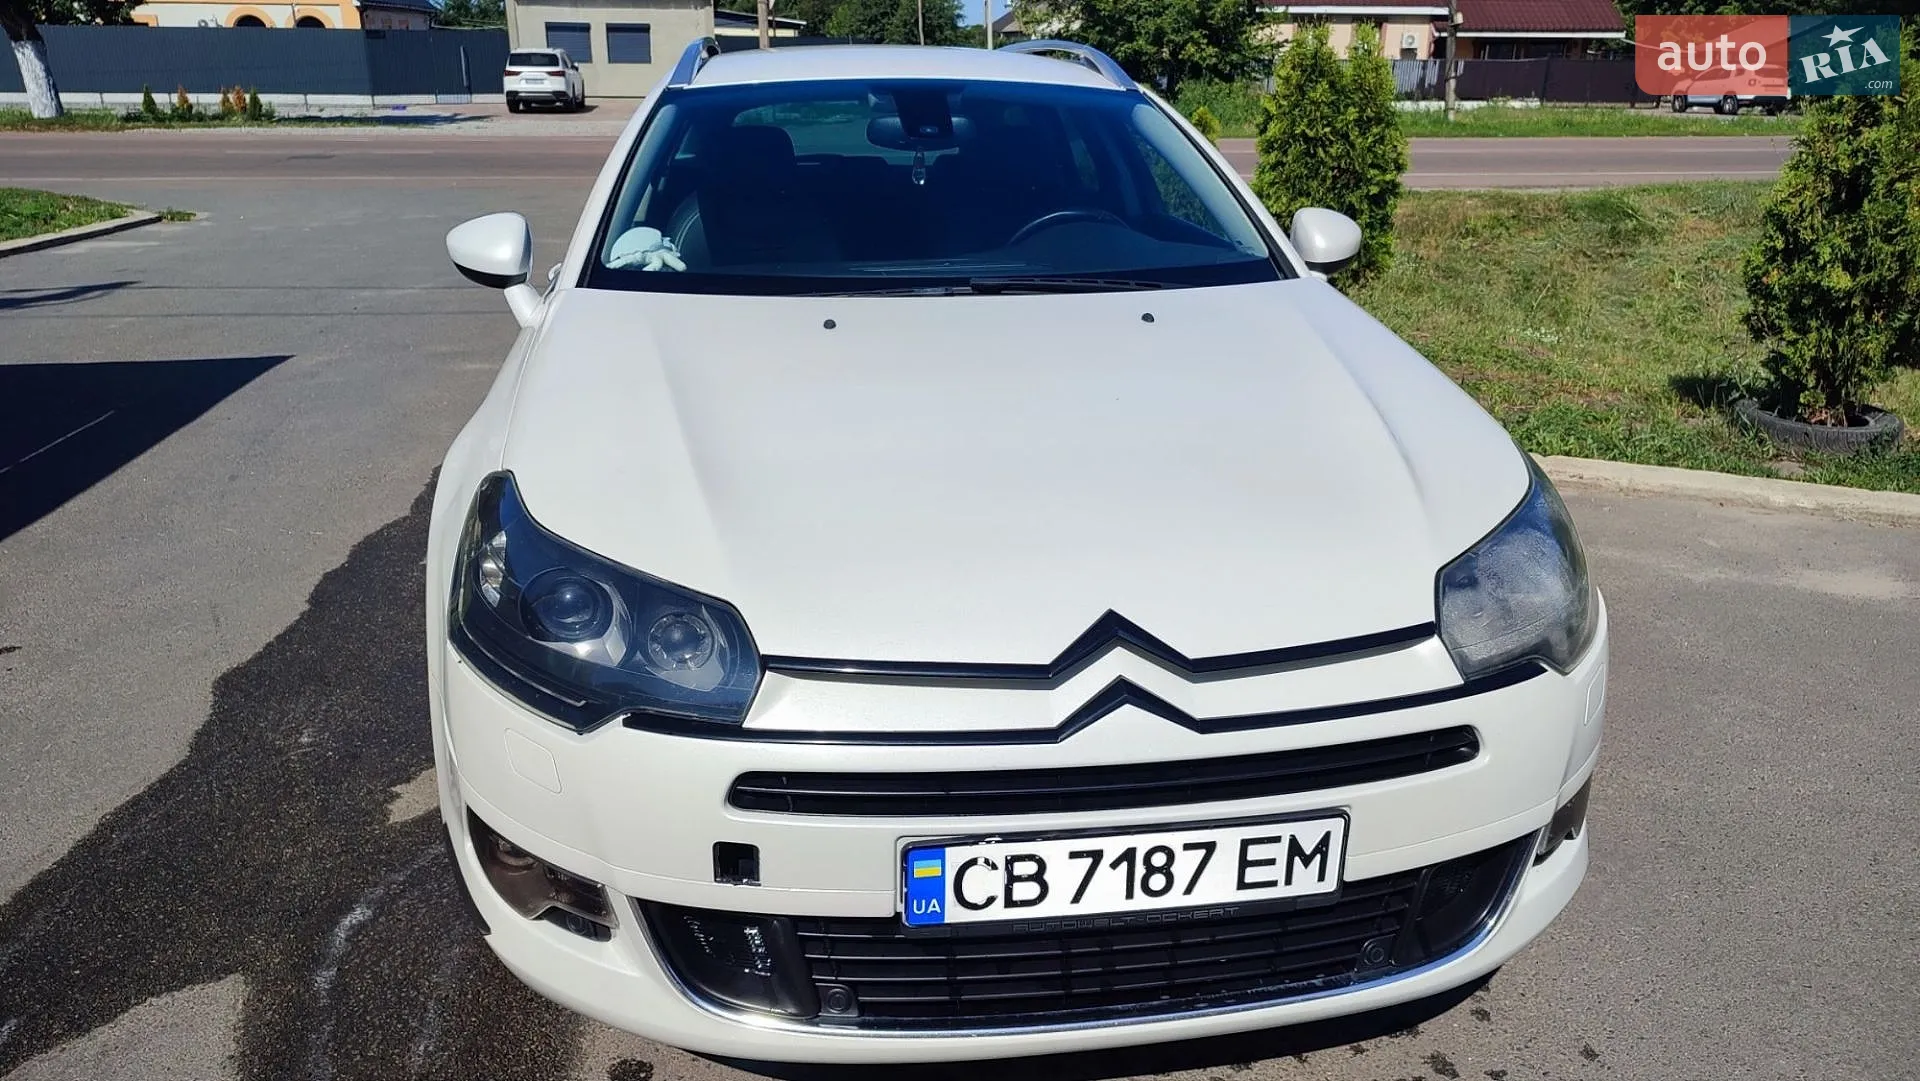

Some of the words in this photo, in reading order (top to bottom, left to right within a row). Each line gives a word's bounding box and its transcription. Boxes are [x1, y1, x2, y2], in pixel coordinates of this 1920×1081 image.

[953, 853, 1049, 910] CB
[1068, 840, 1217, 904] 7187
[1237, 829, 1332, 891] EM
[912, 897, 941, 914] UA
